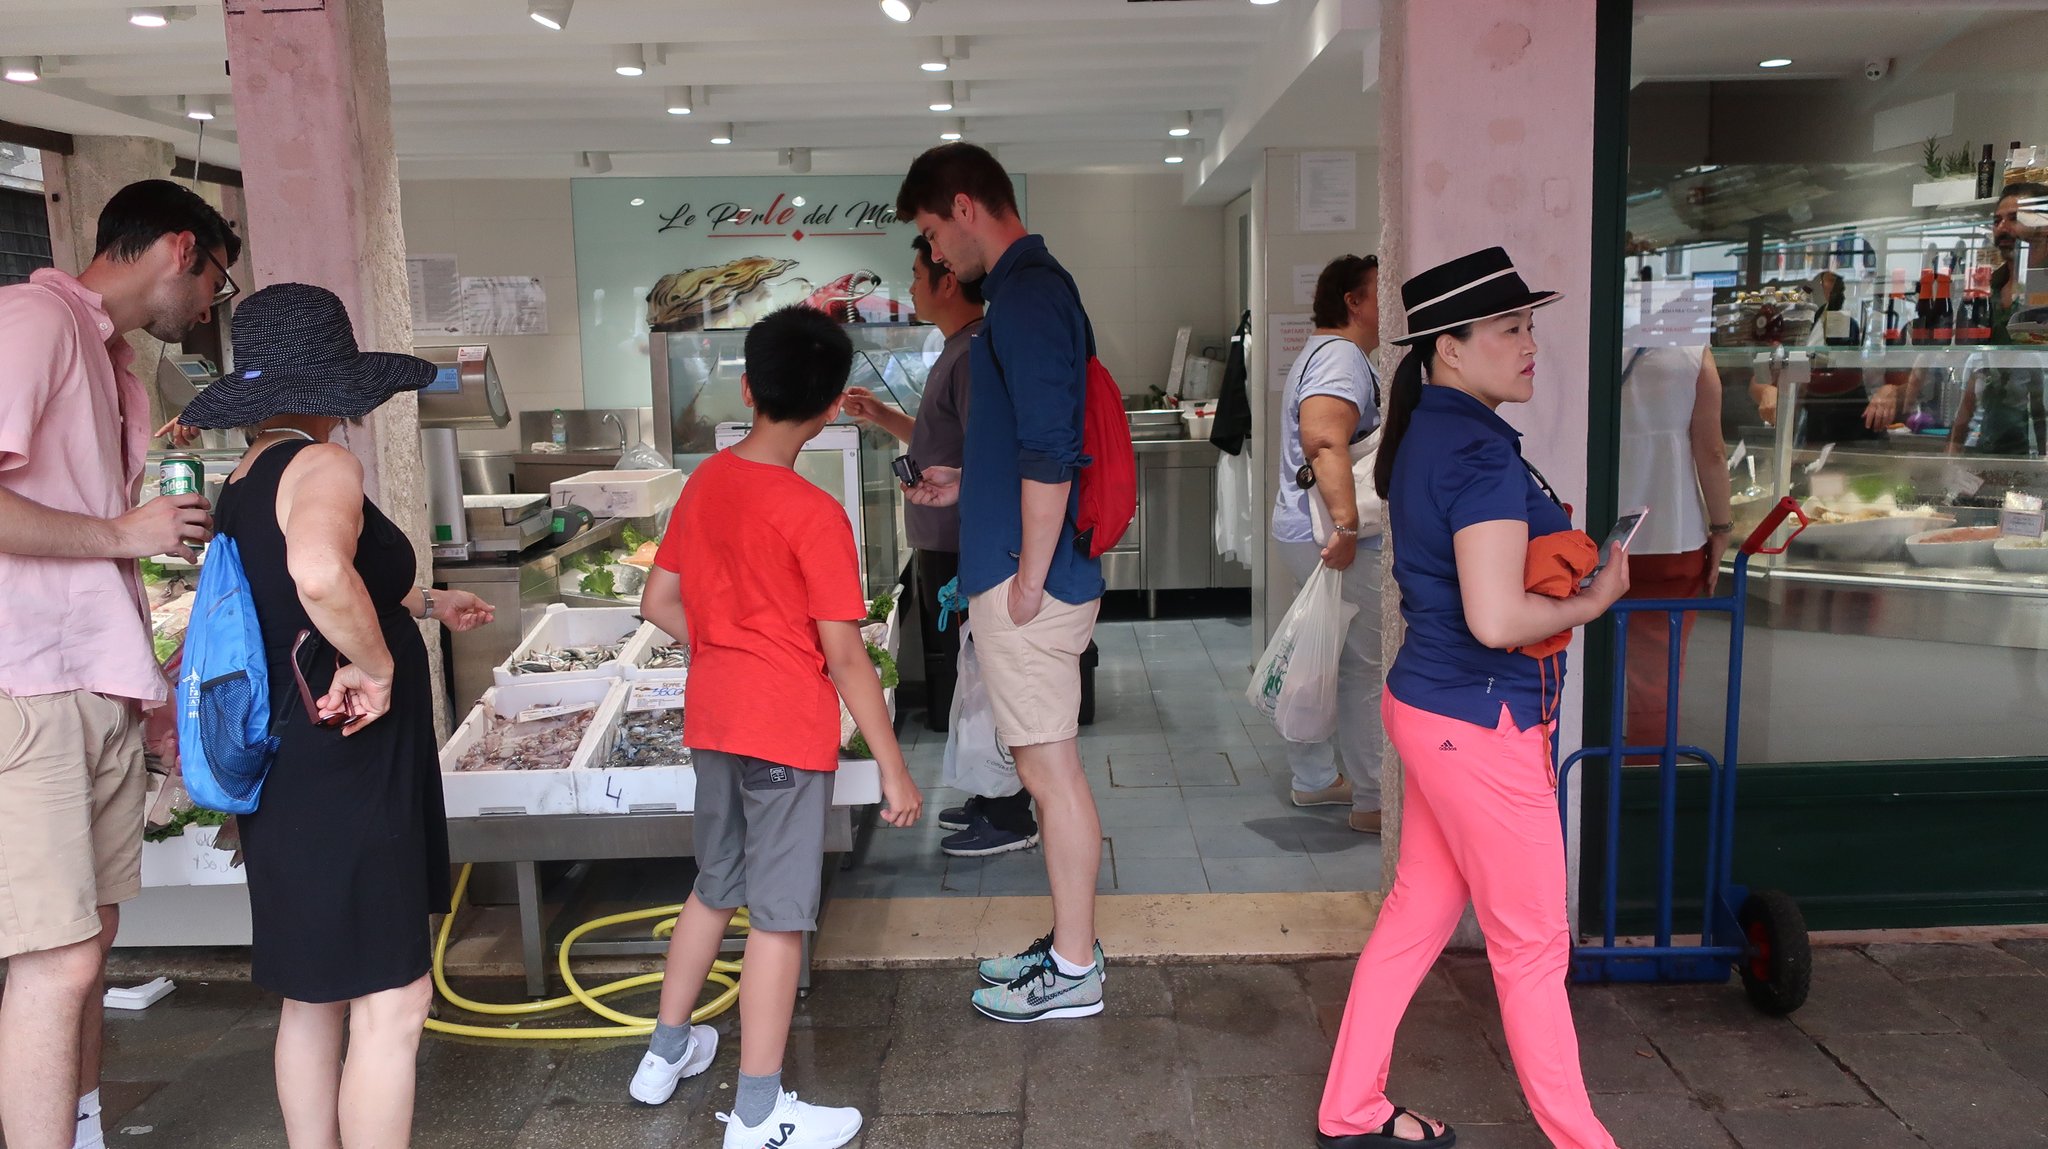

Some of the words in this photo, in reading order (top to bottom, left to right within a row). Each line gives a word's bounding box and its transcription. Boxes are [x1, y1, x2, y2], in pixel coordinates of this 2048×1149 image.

[658, 202, 697, 233] Le
[706, 193, 796, 231] Perle
[802, 204, 838, 225] del
[606, 775, 623, 809] 4
[760, 1123, 796, 1149] ILA
